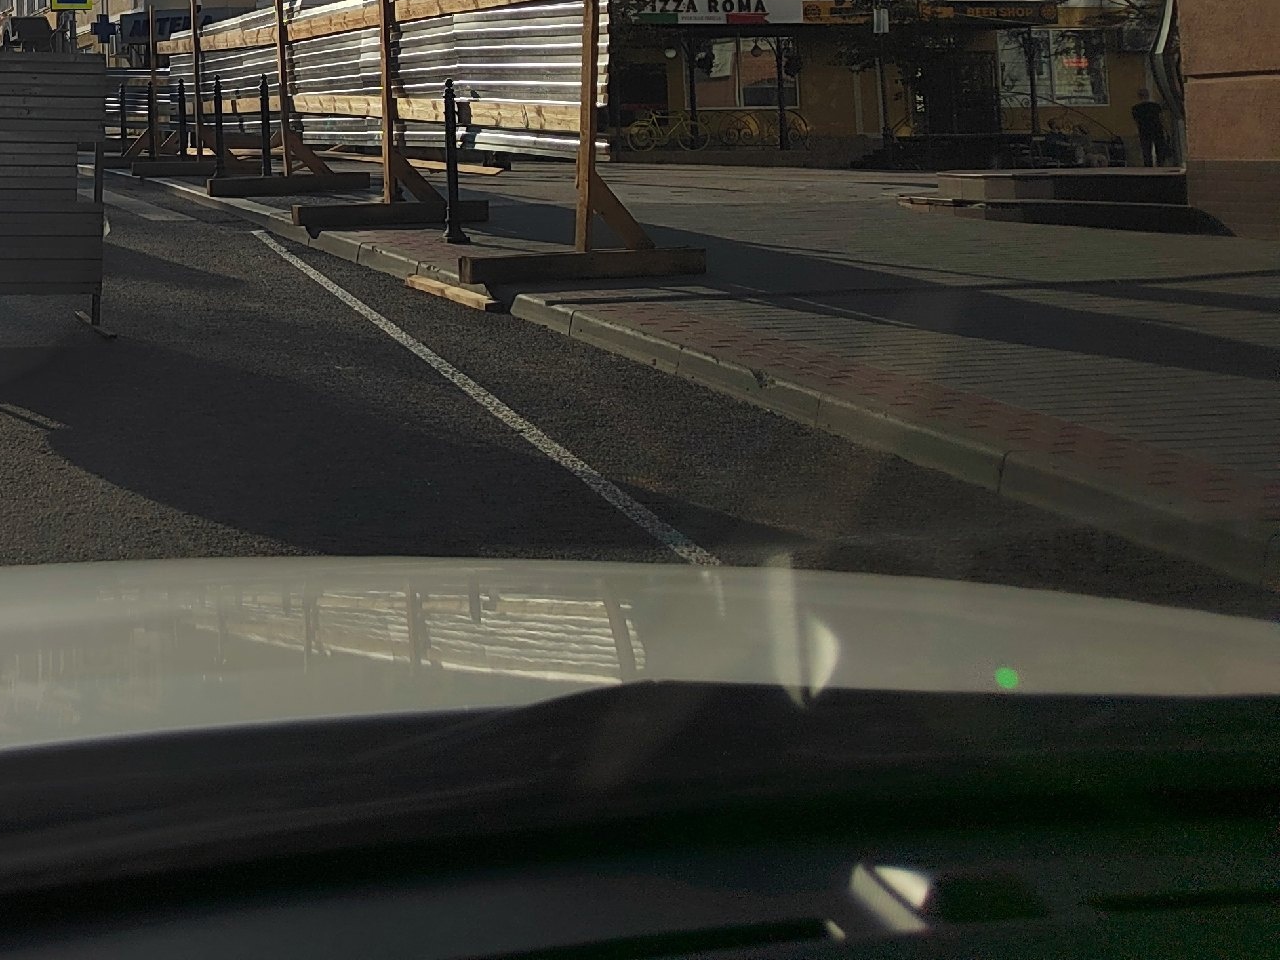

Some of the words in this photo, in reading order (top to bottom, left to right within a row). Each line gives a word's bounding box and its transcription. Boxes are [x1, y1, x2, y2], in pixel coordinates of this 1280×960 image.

[707, 0, 767, 13] ROMA
[966, 6, 997, 17] BEER
[998, 6, 1033, 17] SHOP
